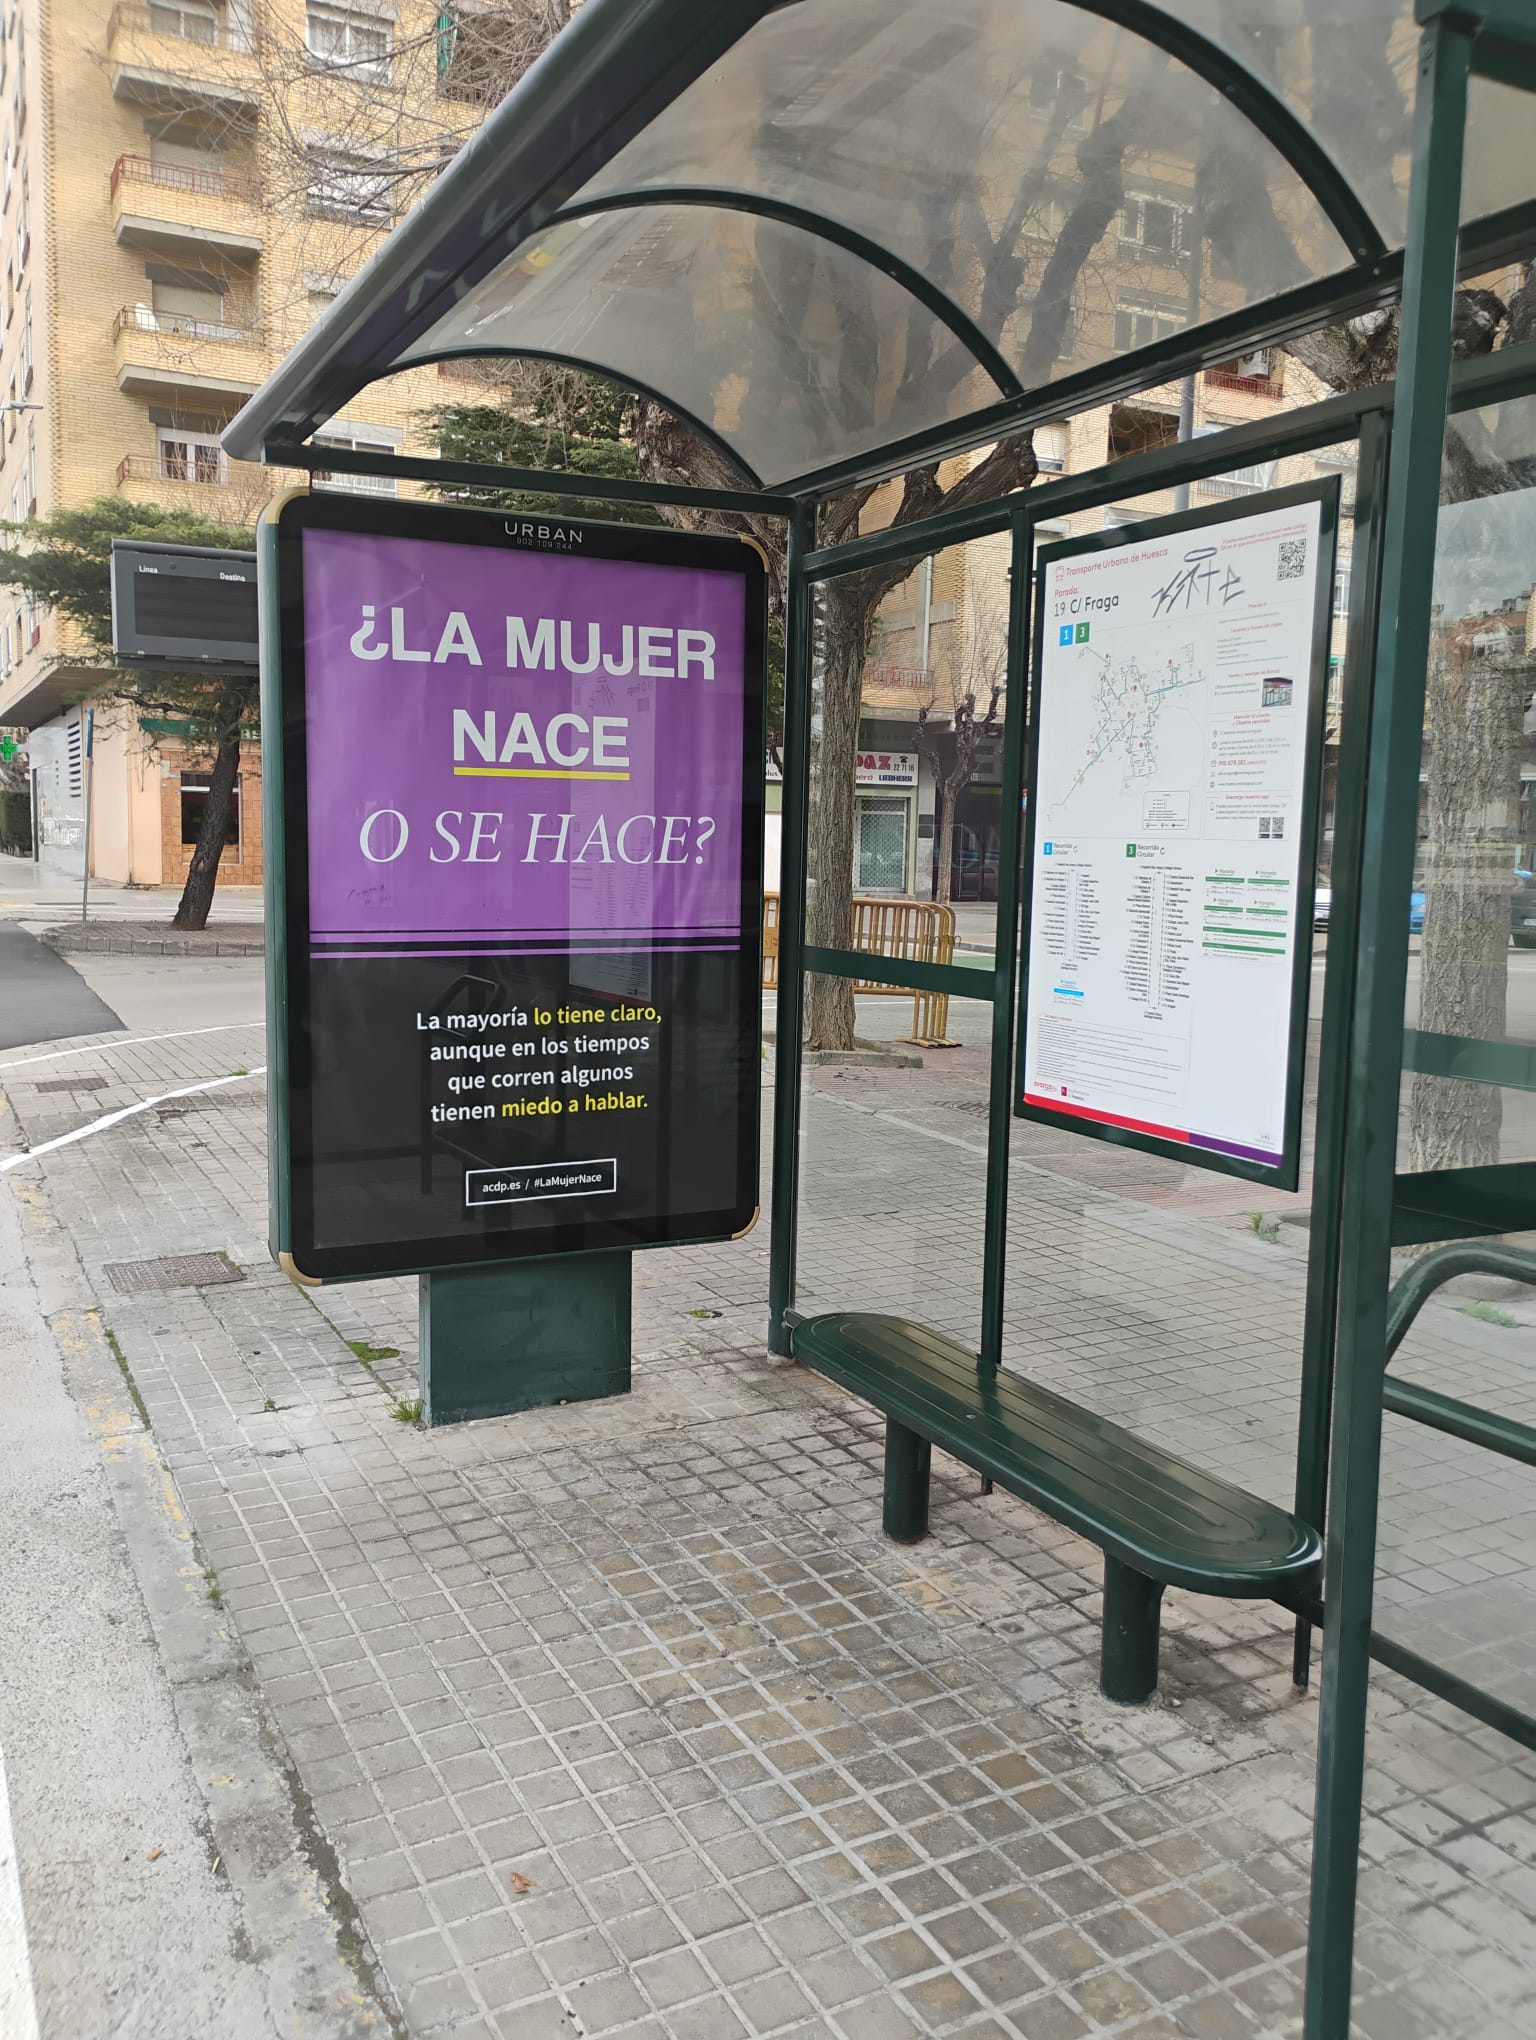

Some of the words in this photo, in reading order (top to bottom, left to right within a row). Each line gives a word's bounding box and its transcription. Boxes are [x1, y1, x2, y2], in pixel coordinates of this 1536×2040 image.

[504, 520, 583, 544] URBAN
[219, 572, 246, 582] Destino
[1066, 562, 1101, 577] Transporte
[1103, 557, 1129, 569] Urbano
[1130, 553, 1140, 563] de
[1141, 548, 1168, 561] Huesca
[1053, 601, 1066, 617] 19
[1070, 597, 1082, 614] C/
[1084, 595, 1119, 612] Fraga
[350, 605, 482, 666] ¿LA
[506, 615, 716, 680] MUJER
[453, 709, 630, 767] NACE
[879, 774, 912, 782] LIEBHERR
[359, 809, 409, 863] O
[429, 810, 503, 863] SE
[520, 812, 716, 865] HACE?
[416, 1012, 441, 1030] La
[447, 1006, 528, 1033] mayoría
[534, 1007, 552, 1026] lo
[557, 1006, 605, 1024] tiene
[610, 1004, 662, 1025] claro,
[430, 1042, 506, 1063] aunque
[512, 1042, 536, 1057] en
[541, 1036, 569, 1055] los
[573, 1034, 650, 1055] tiempos
[448, 1073, 486, 1095] que
[491, 1070, 555, 1088] corren
[560, 1064, 634, 1088] algunos
[430, 1101, 496, 1123] tienen
[502, 1096, 563, 1118] miedo
[568, 1100, 579, 1113] a
[585, 1091, 648, 1113] hablar.
[482, 1179, 521, 1194] acdp.es
[533, 1171, 603, 1190] #LaMujerNace
